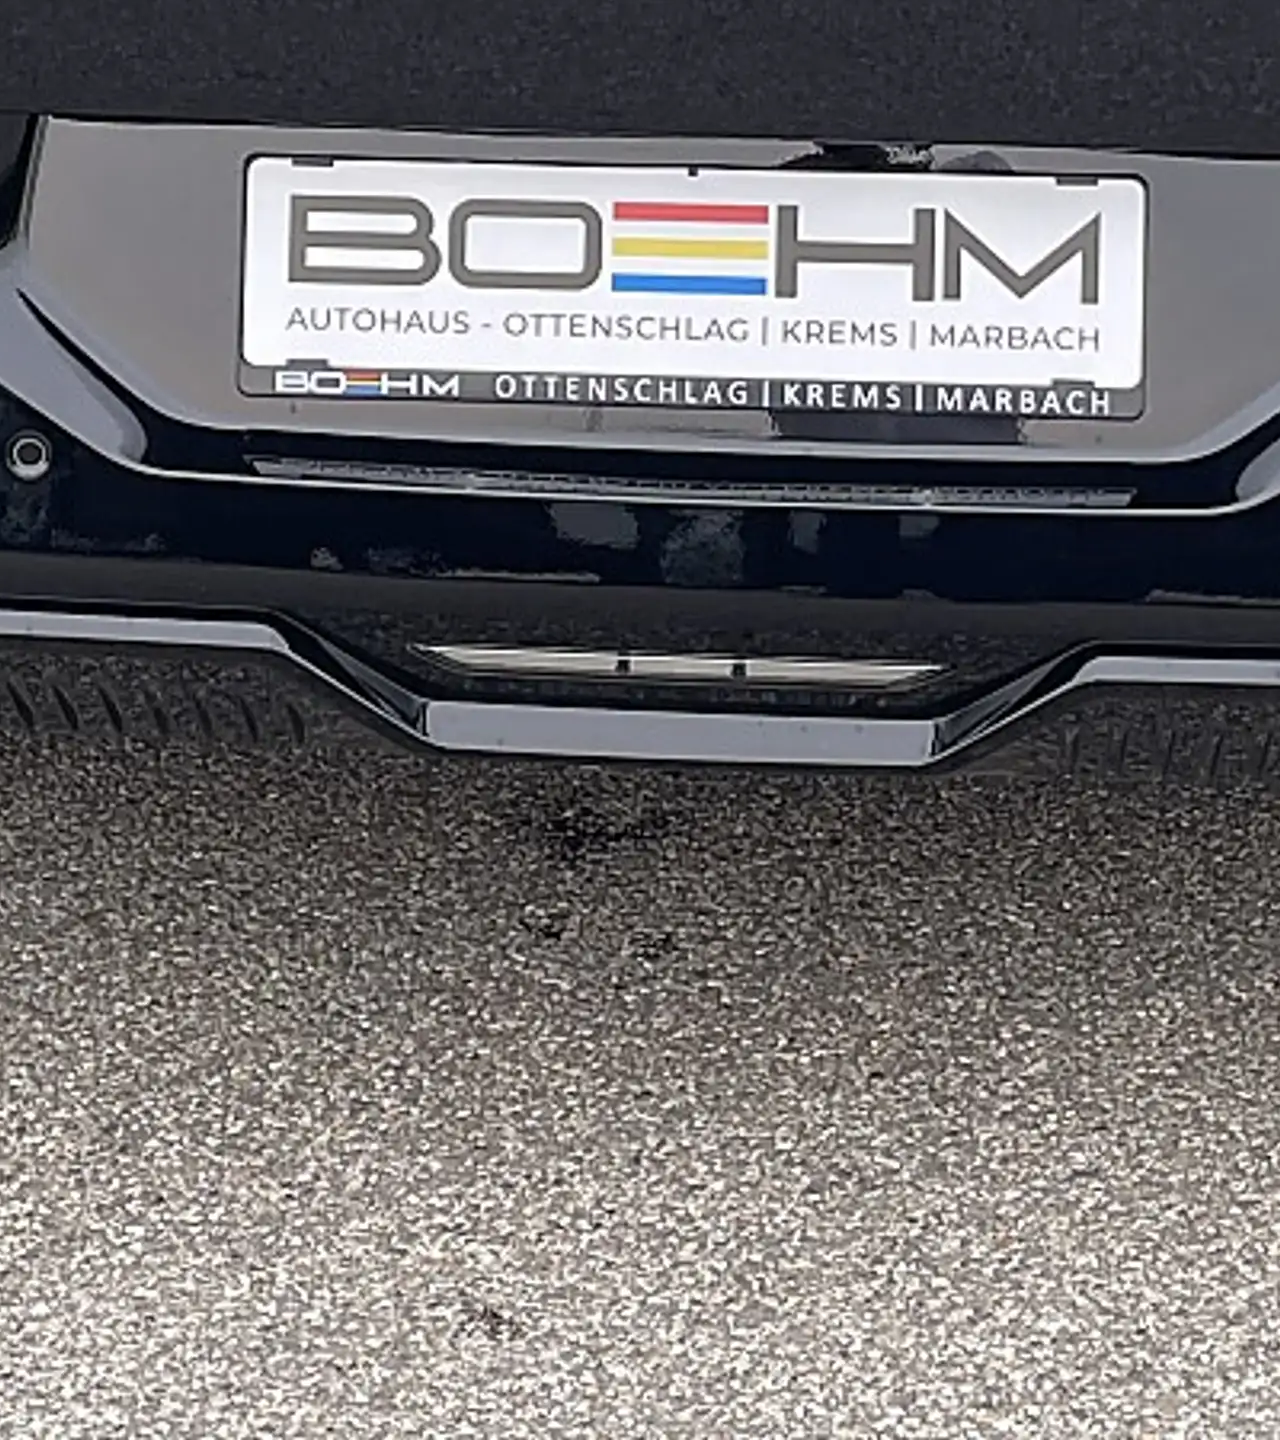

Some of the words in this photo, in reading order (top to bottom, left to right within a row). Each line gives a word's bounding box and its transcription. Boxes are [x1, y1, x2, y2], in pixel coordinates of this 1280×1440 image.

[287, 194, 1102, 305] BOEHM
[285, 307, 470, 334] AUTOHAUS
[502, 312, 748, 341] OTTENSCHLAG
[782, 319, 897, 346] KREMS
[929, 323, 1100, 352] MARBACH
[274, 369, 460, 396] BOEHM
[495, 374, 748, 405] OTTENSCHLAG
[783, 383, 901, 409] KREMS
[937, 387, 1110, 416] MARBACH
